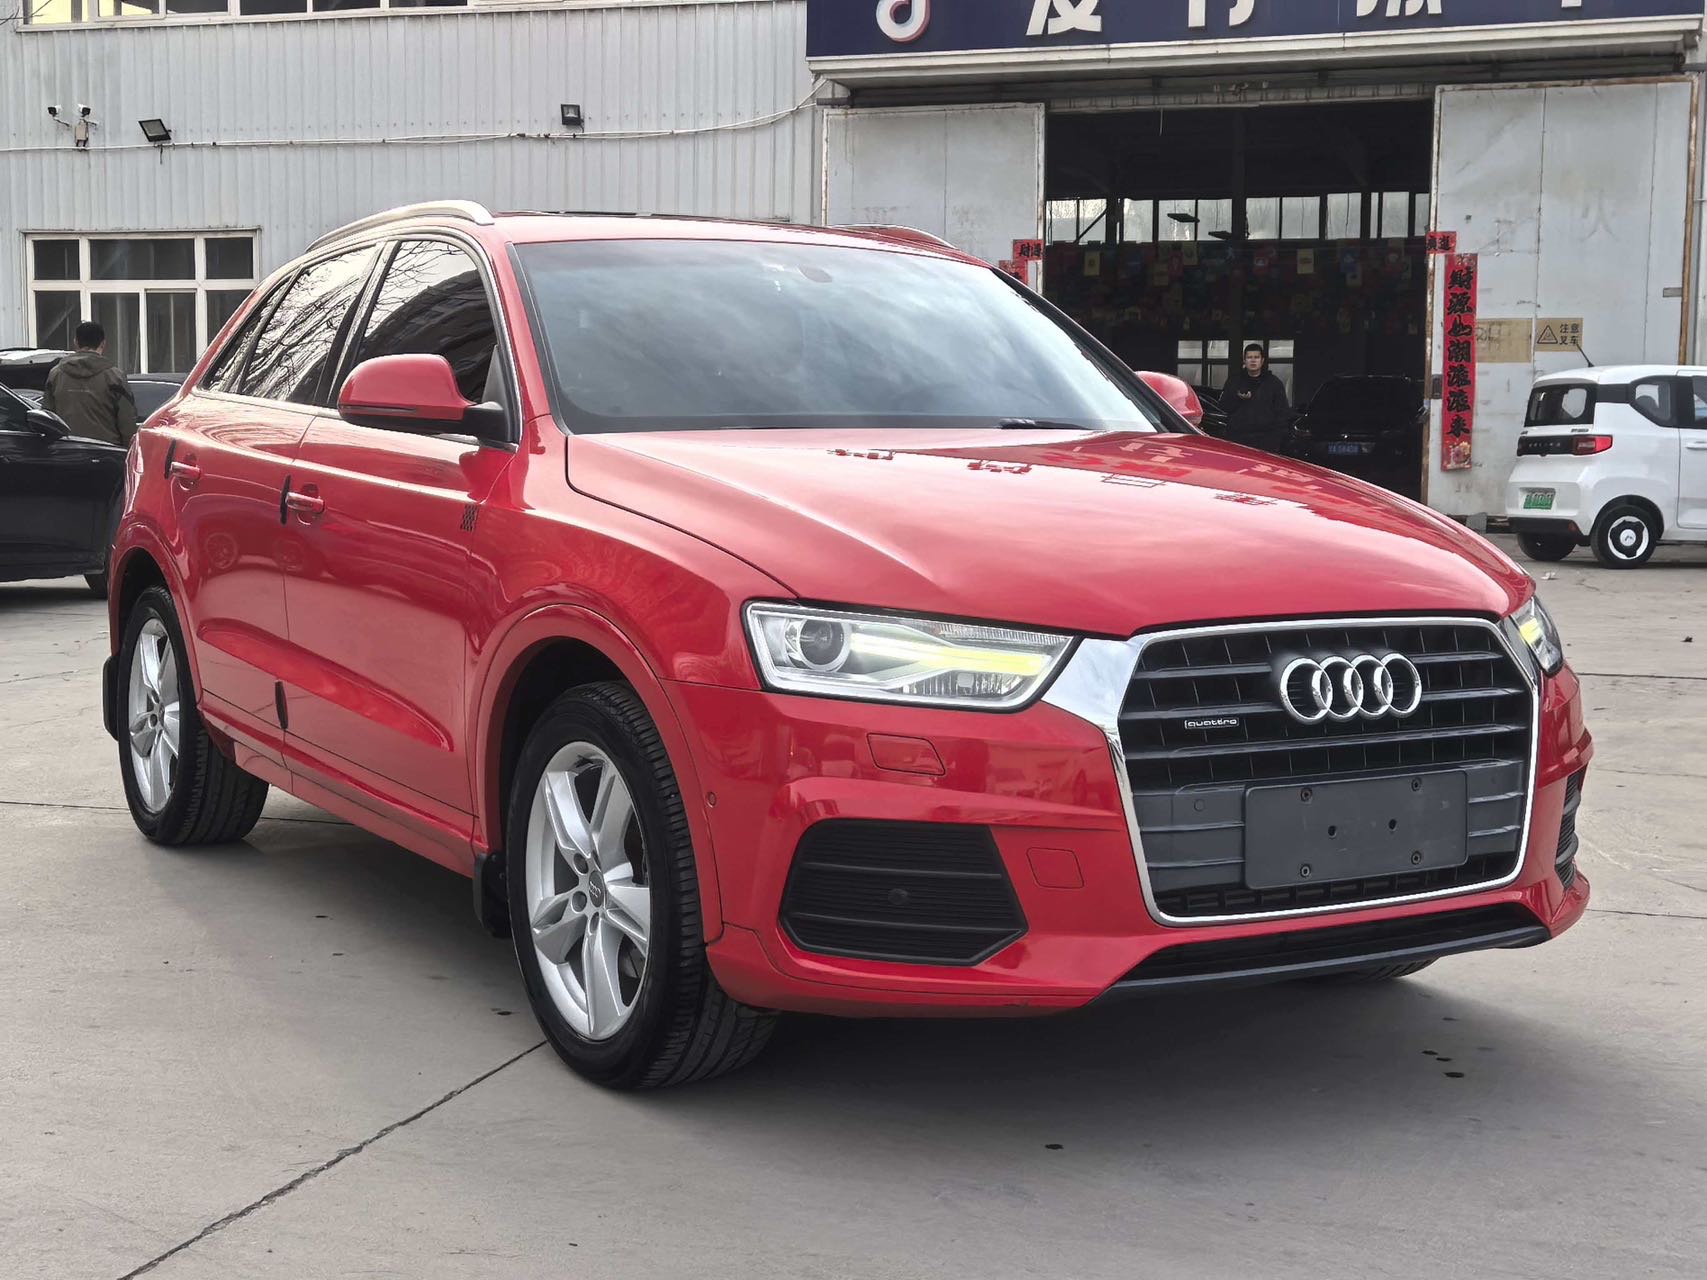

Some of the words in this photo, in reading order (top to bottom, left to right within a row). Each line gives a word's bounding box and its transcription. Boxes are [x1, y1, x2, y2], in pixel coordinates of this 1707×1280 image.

[1559, 323, 1580, 334] 注意
[1559, 335, 1580, 346] 叉车
[1187, 718, 1237, 727] quattro
